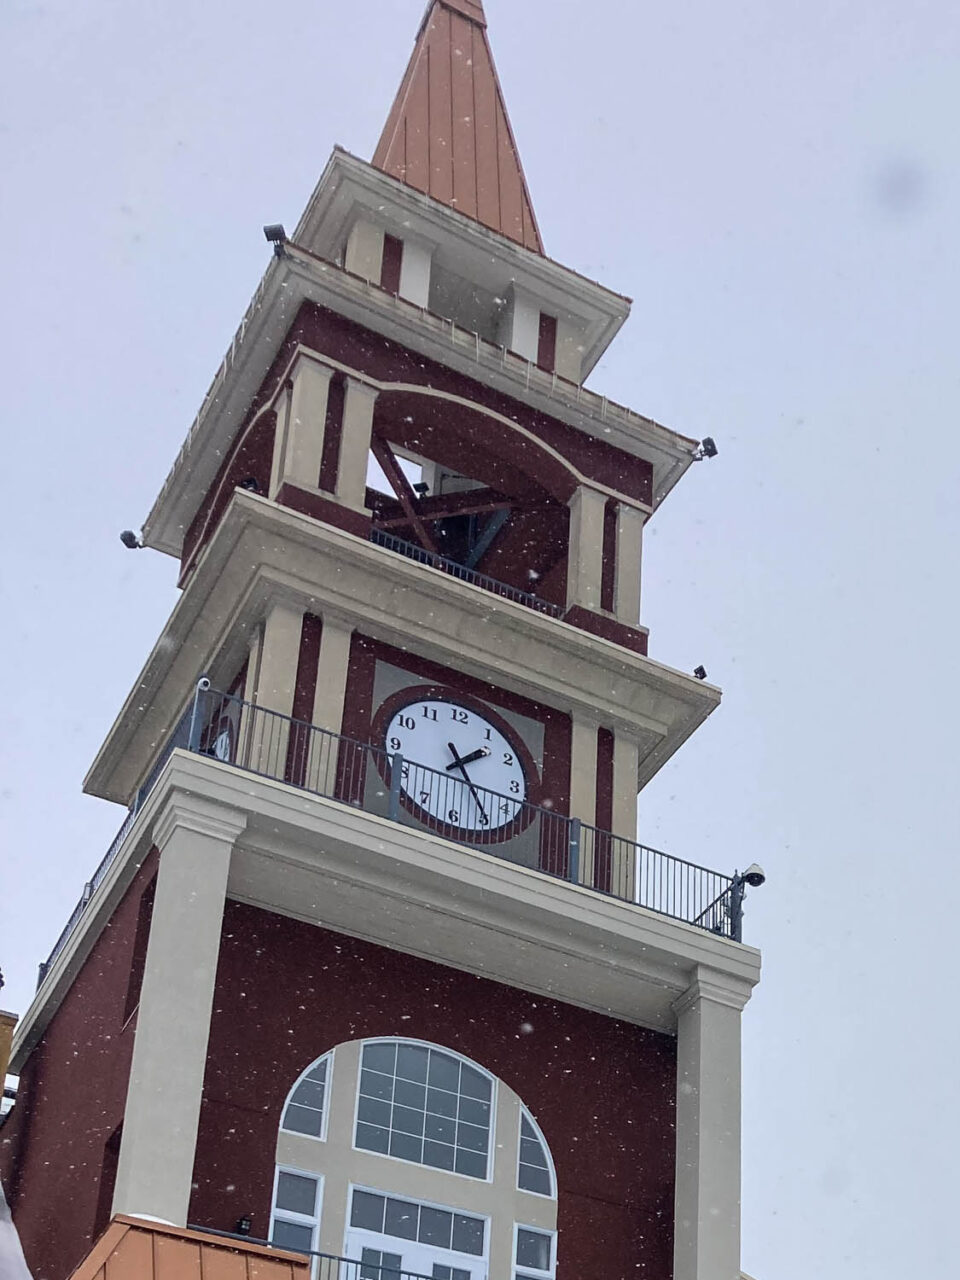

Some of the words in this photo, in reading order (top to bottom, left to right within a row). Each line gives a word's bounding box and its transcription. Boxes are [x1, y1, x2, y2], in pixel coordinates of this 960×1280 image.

[421, 706, 439, 722] 11
[450, 708, 469, 725] 12
[398, 714, 416, 730] 10
[484, 728, 492, 741] 1
[390, 737, 401, 750] 9
[503, 753, 513, 766] 2
[509, 780, 520, 794] 3
[420, 791, 430, 804] 7
[499, 803, 510, 815] 4
[448, 810, 459, 823] 6
[478, 812, 489, 826] 5
